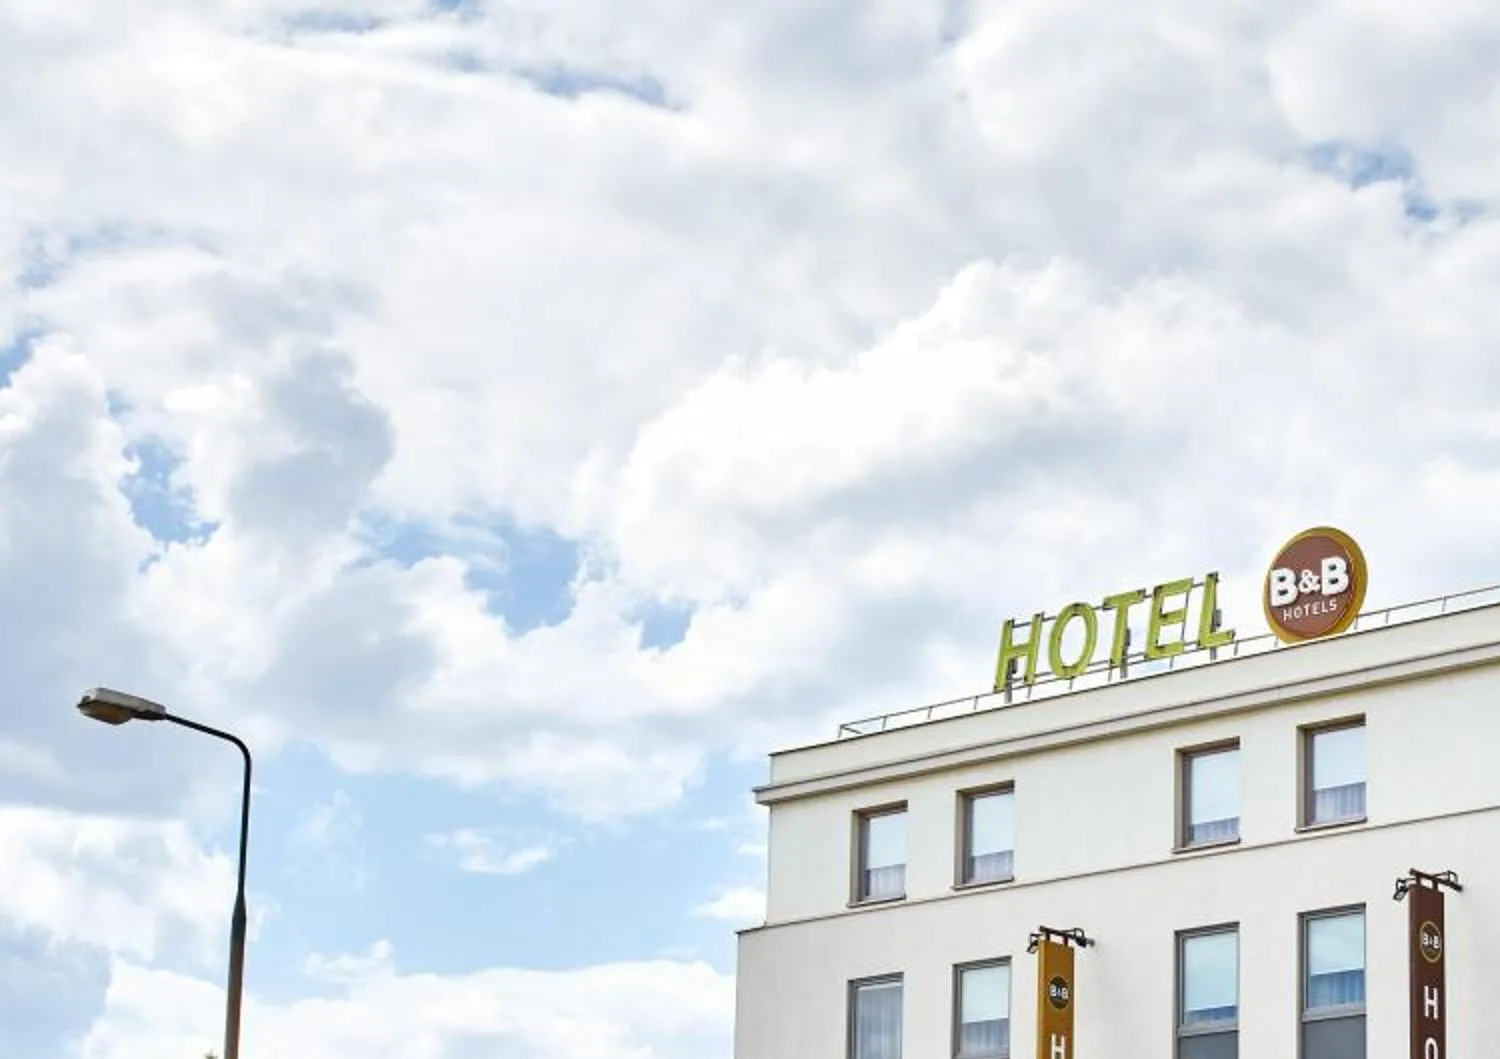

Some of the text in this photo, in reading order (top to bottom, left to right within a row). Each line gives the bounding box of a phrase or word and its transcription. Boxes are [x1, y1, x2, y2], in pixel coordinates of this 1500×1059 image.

[992, 556, 1351, 694] HOTEL B&B
[1282, 598, 1338, 622] HOTELS
